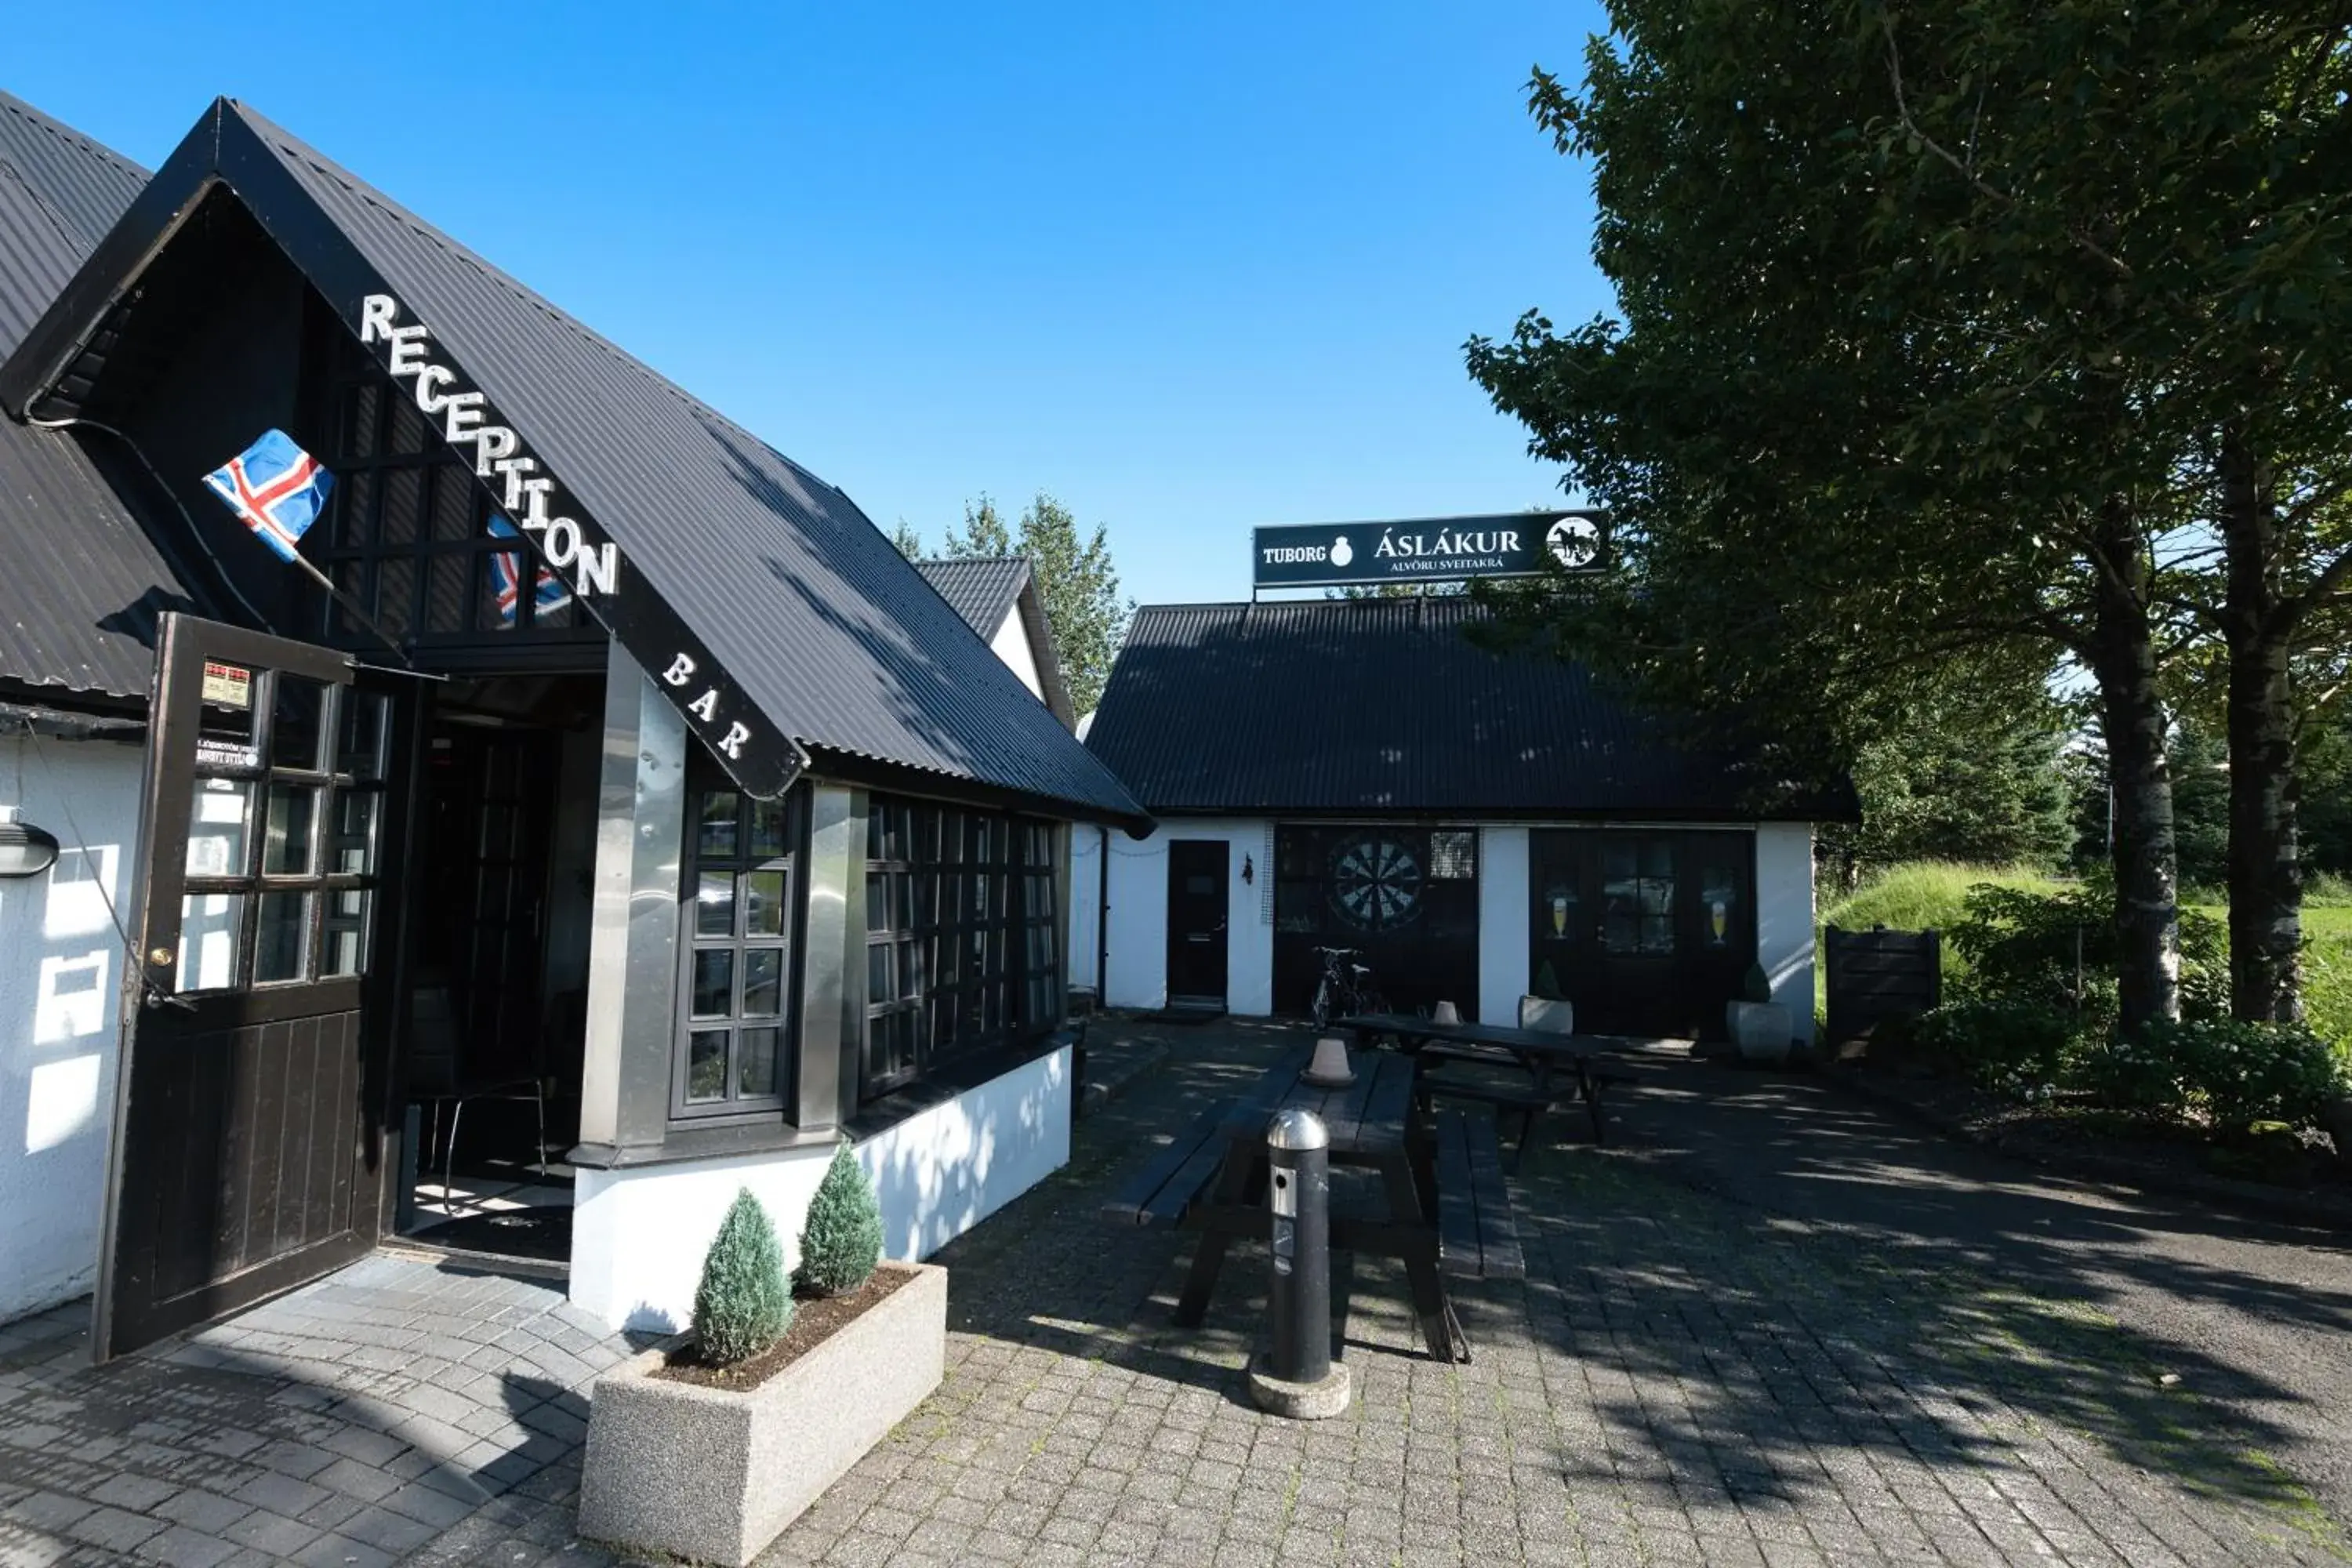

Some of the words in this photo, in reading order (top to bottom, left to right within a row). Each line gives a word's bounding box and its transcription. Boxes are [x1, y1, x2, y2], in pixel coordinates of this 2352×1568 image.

[361, 293, 620, 595] RECEPTION
[1263, 546, 1326, 564] TUBORG
[1374, 526, 1523, 557] ÁSLÁKUR
[1390, 560, 1438, 572] ALVÖRU
[1439, 555, 1504, 569] SVEITAKRÁ
[662, 652, 752, 760] BAR
